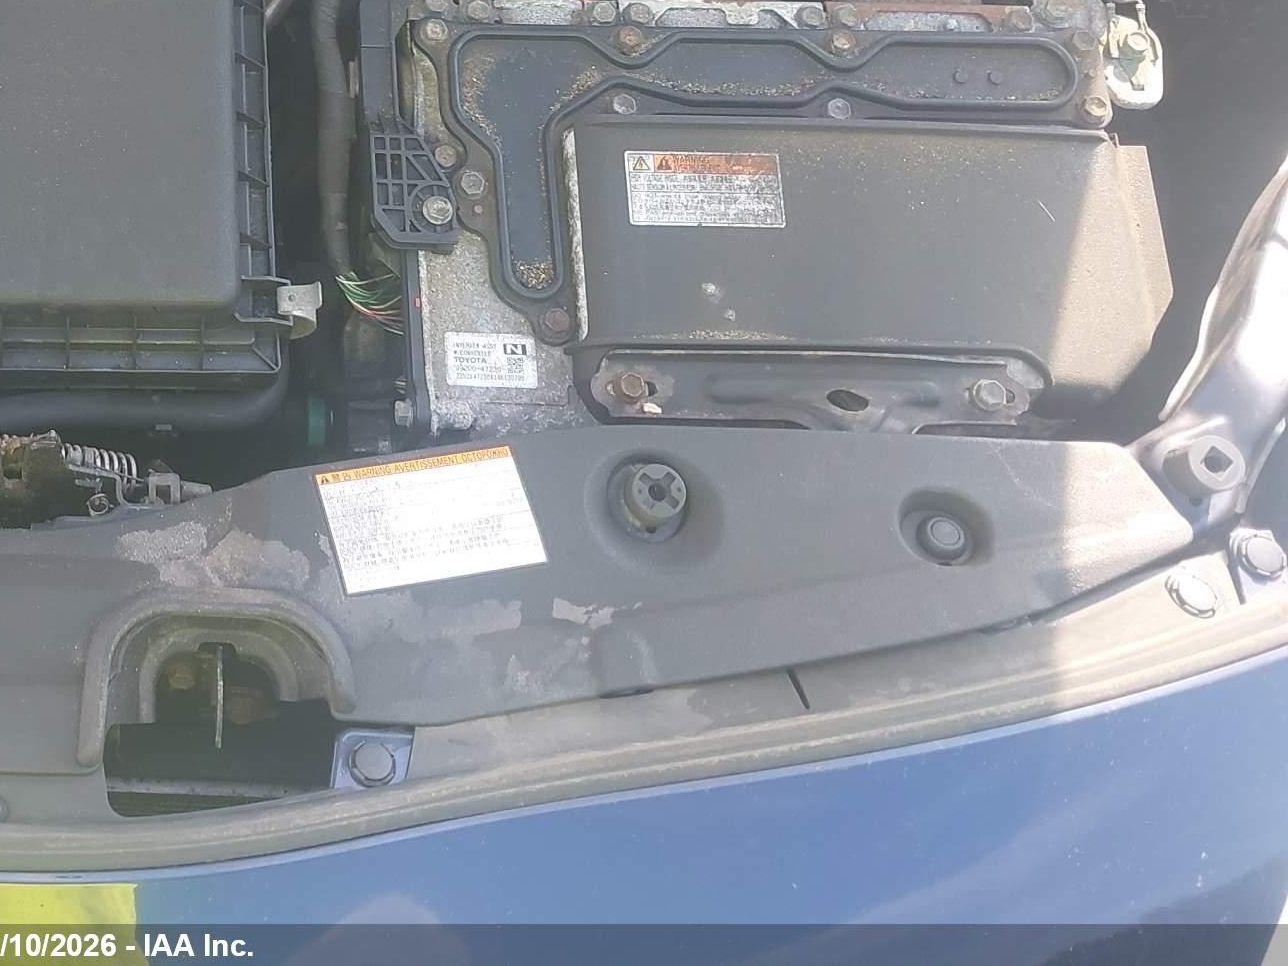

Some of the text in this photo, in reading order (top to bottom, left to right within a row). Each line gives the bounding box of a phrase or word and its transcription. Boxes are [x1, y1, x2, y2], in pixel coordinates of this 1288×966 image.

[505, 343, 524, 355] N
[353, 464, 392, 481] WARNING
[394, 455, 459, 473] AVERTISSEMENT
